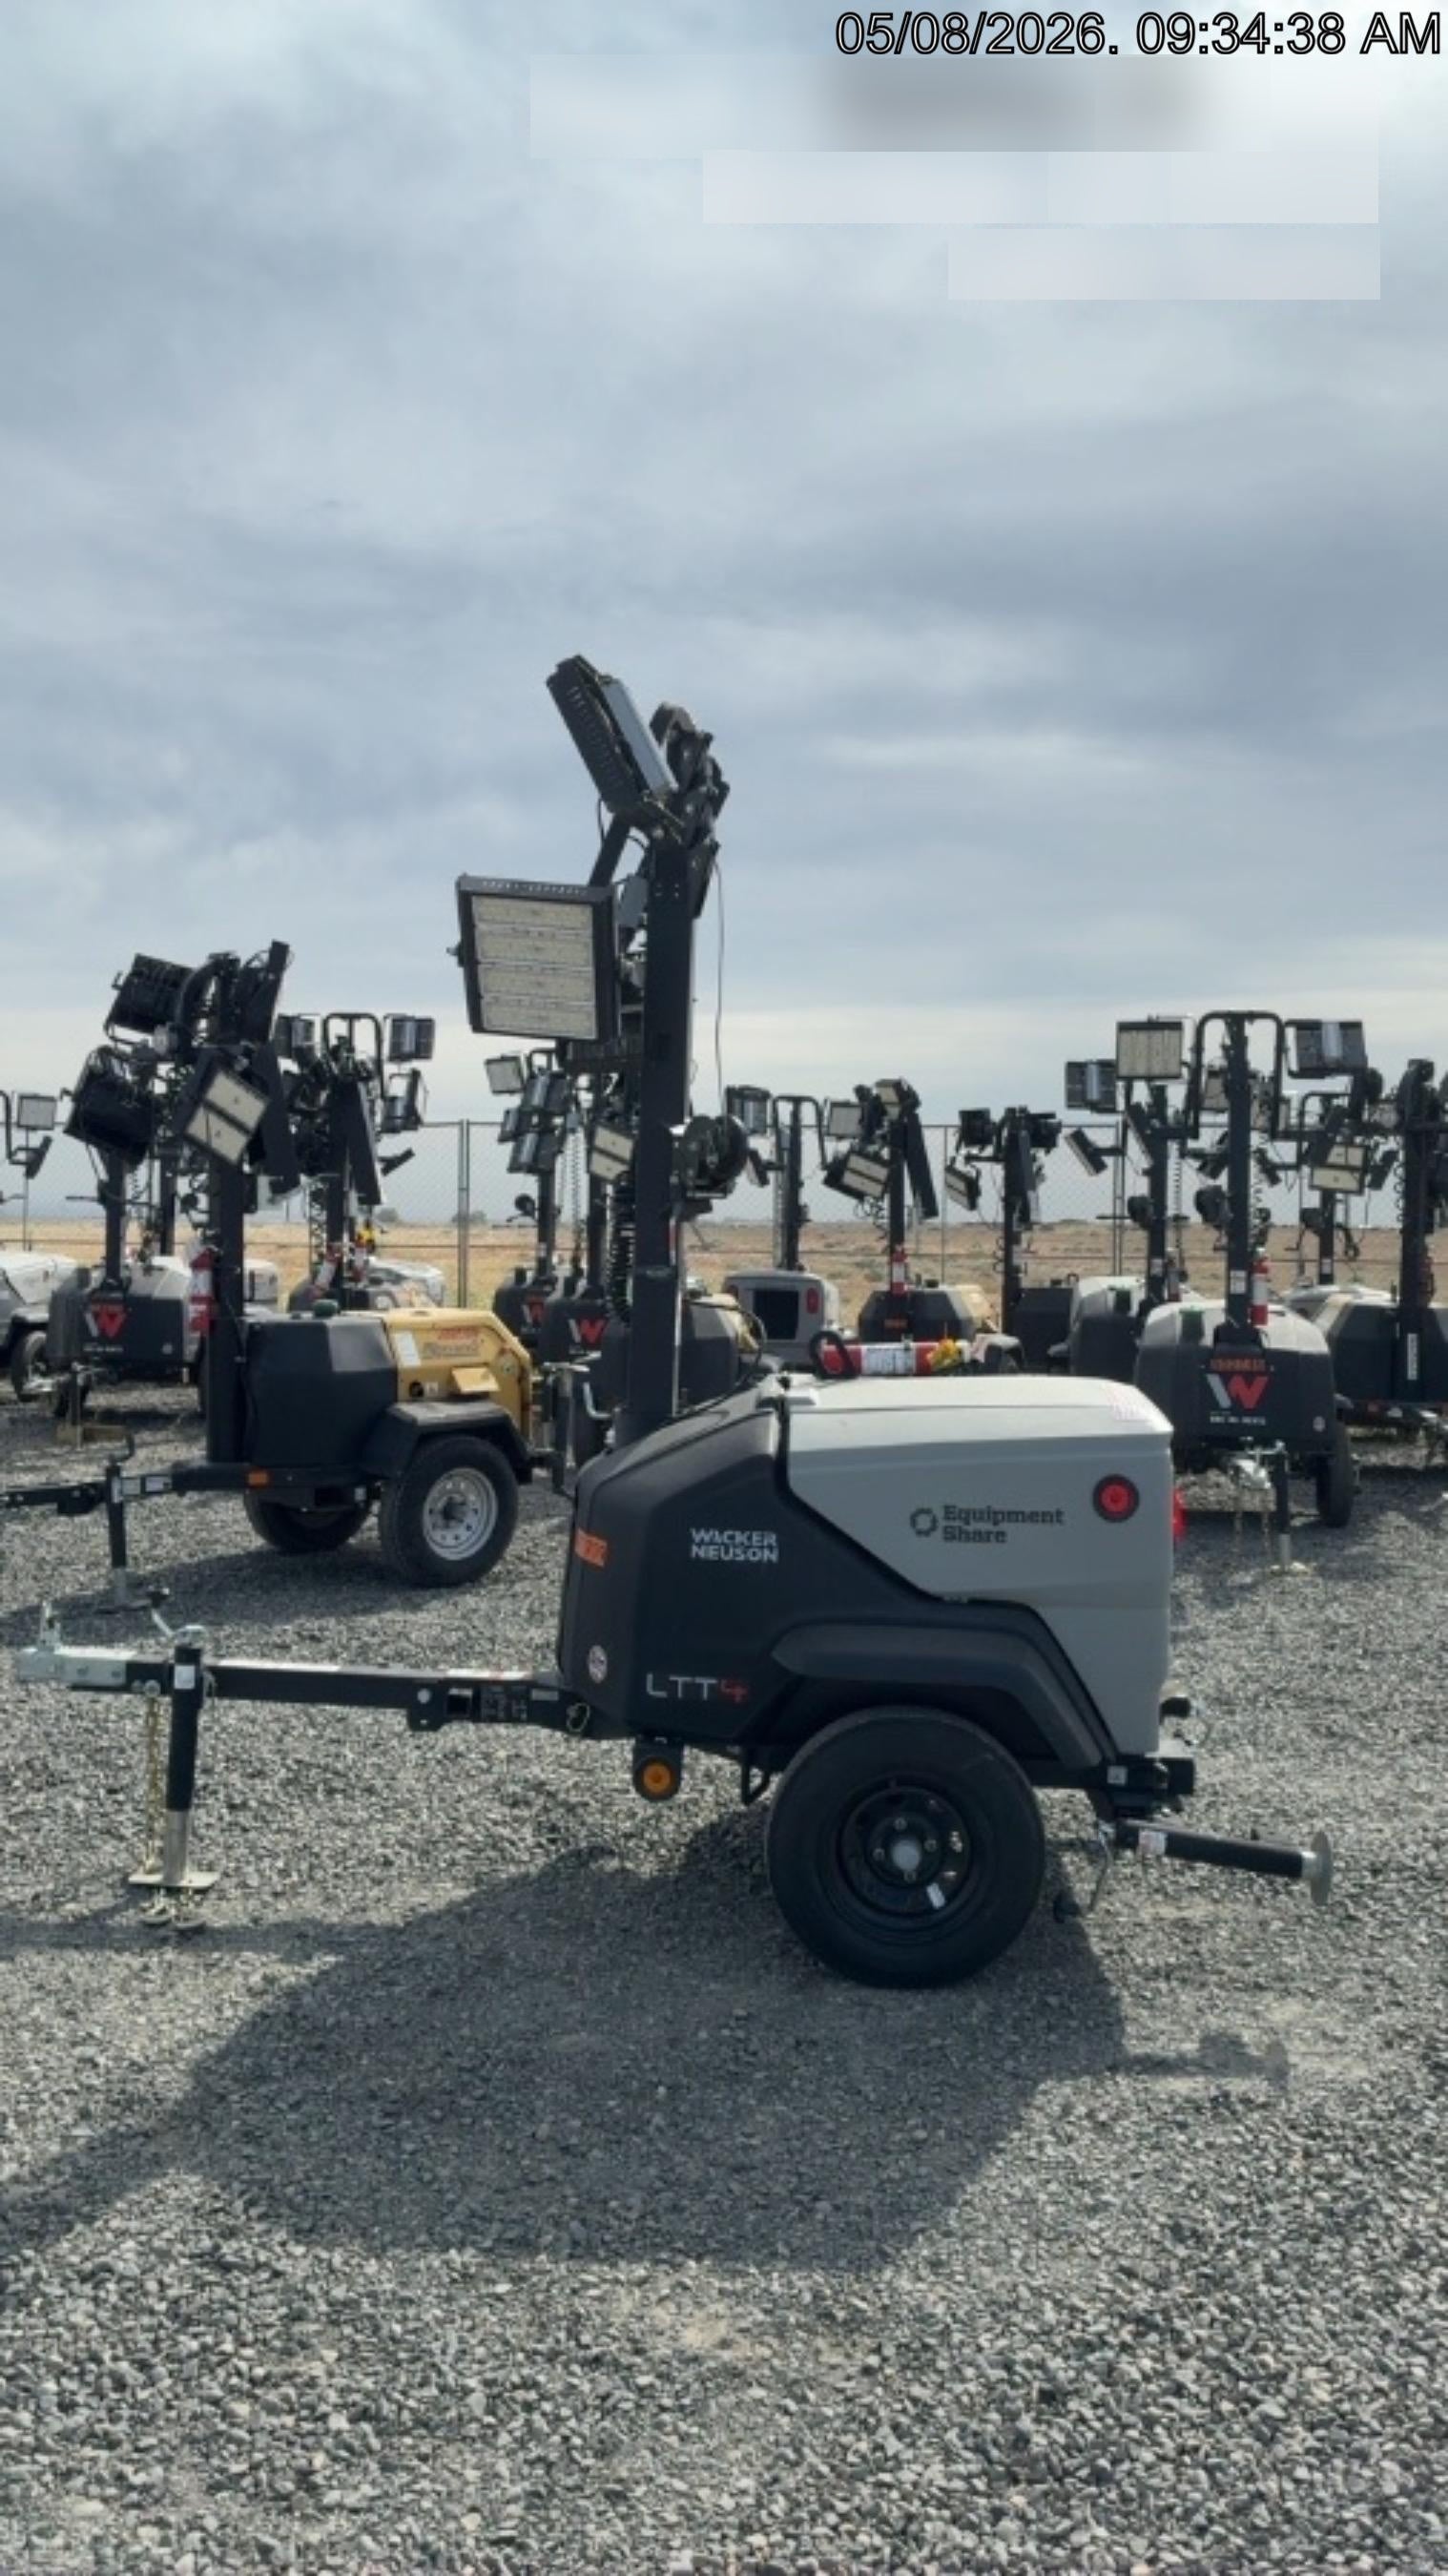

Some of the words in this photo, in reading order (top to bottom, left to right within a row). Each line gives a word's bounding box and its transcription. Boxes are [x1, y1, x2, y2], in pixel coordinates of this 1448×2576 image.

[942, 1505, 1065, 1527] Equipment
[689, 1527, 777, 1547] WACKER
[942, 1526, 1008, 1544] Share
[690, 1545, 779, 1563] NEUSON
[646, 1672, 749, 1703] LTT4
